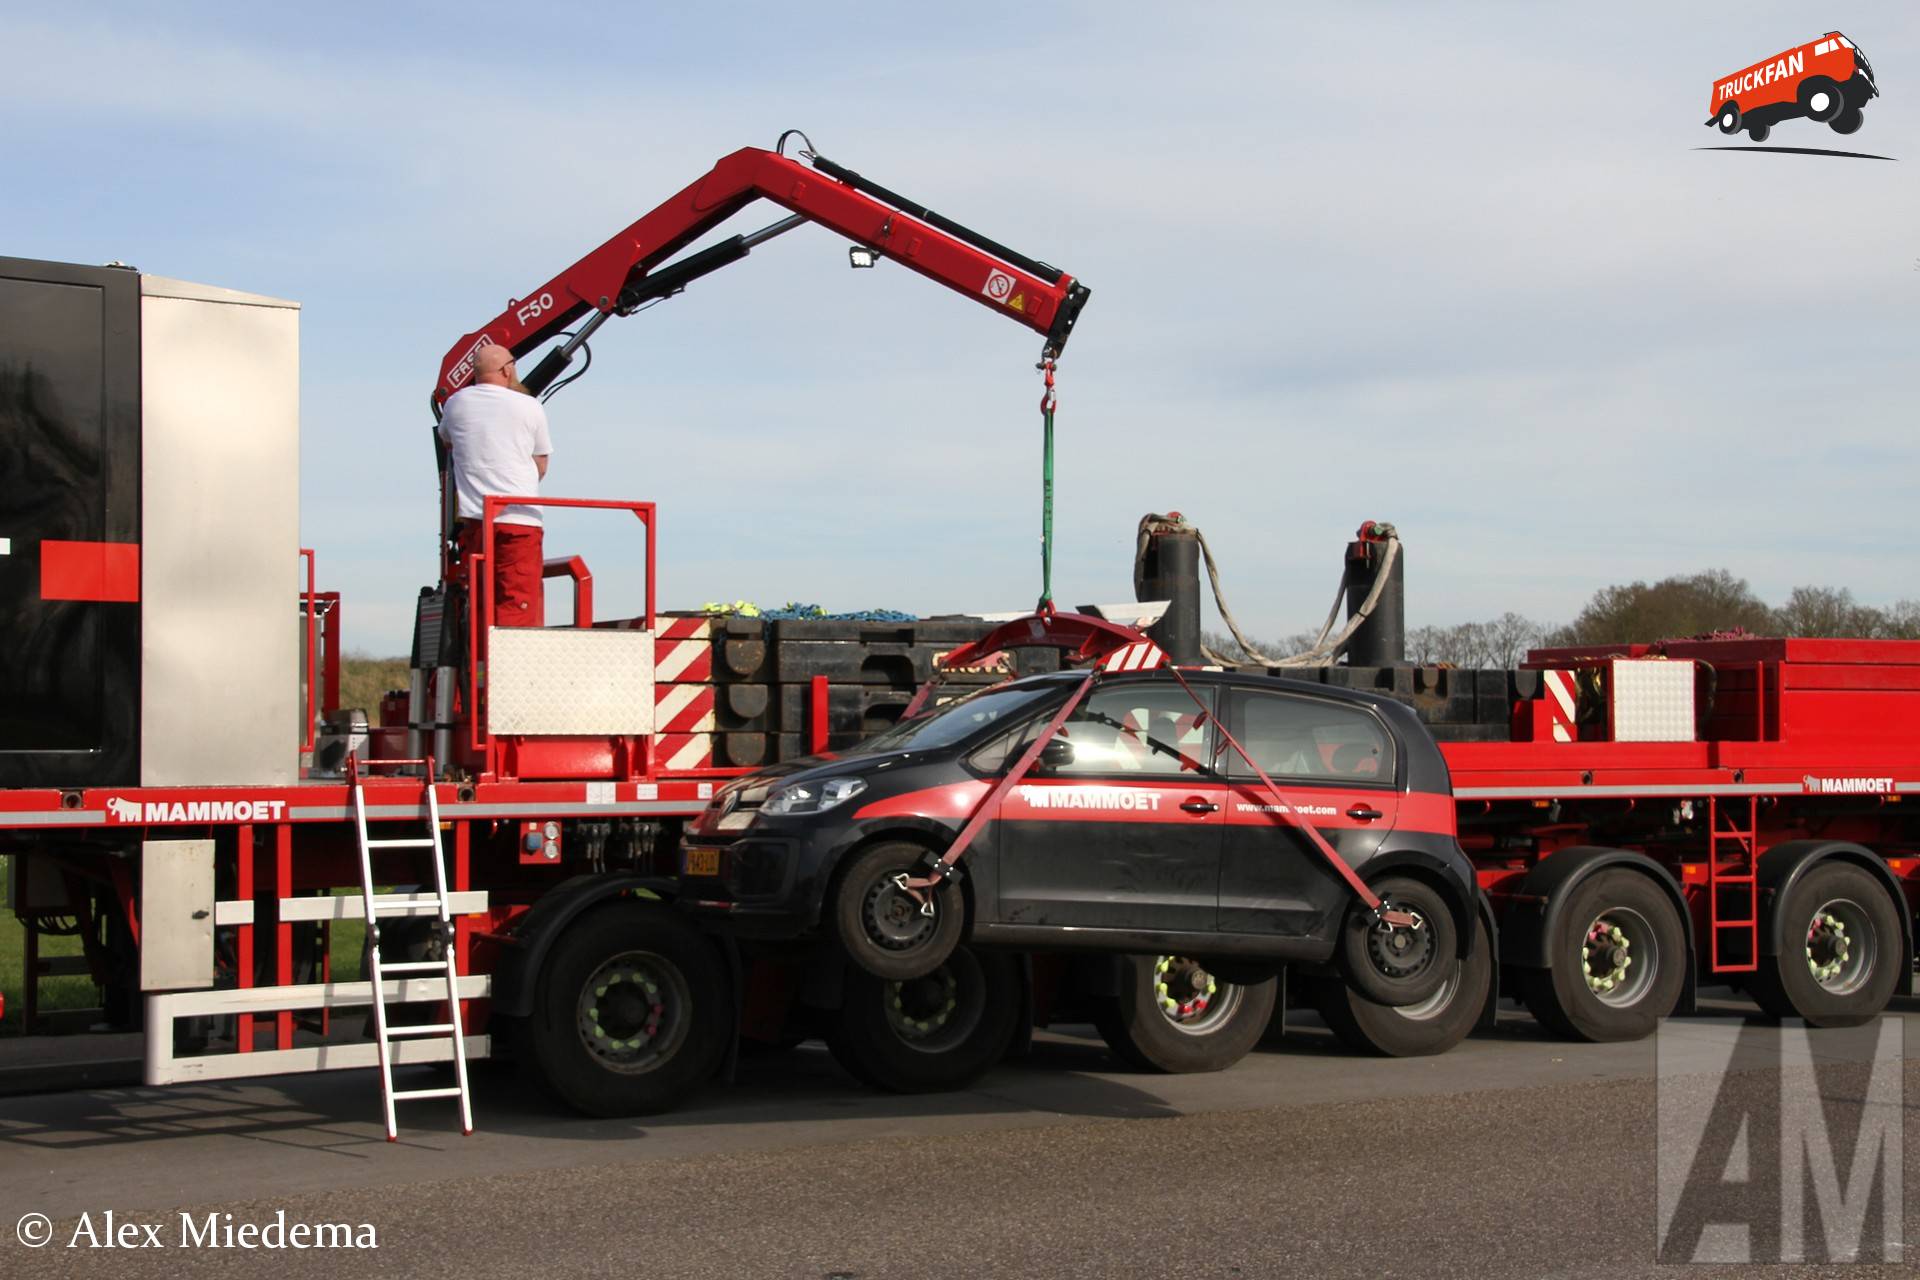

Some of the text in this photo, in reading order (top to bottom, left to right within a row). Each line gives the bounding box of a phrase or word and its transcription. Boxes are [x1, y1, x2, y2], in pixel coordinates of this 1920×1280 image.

[516, 292, 554, 326] F50
[1821, 777, 1893, 793] MAMMOET
[1050, 791, 1161, 811] MAMMOET
[1236, 803, 1337, 815] www.mamoet.com
[145, 800, 286, 823] MAMMOET
